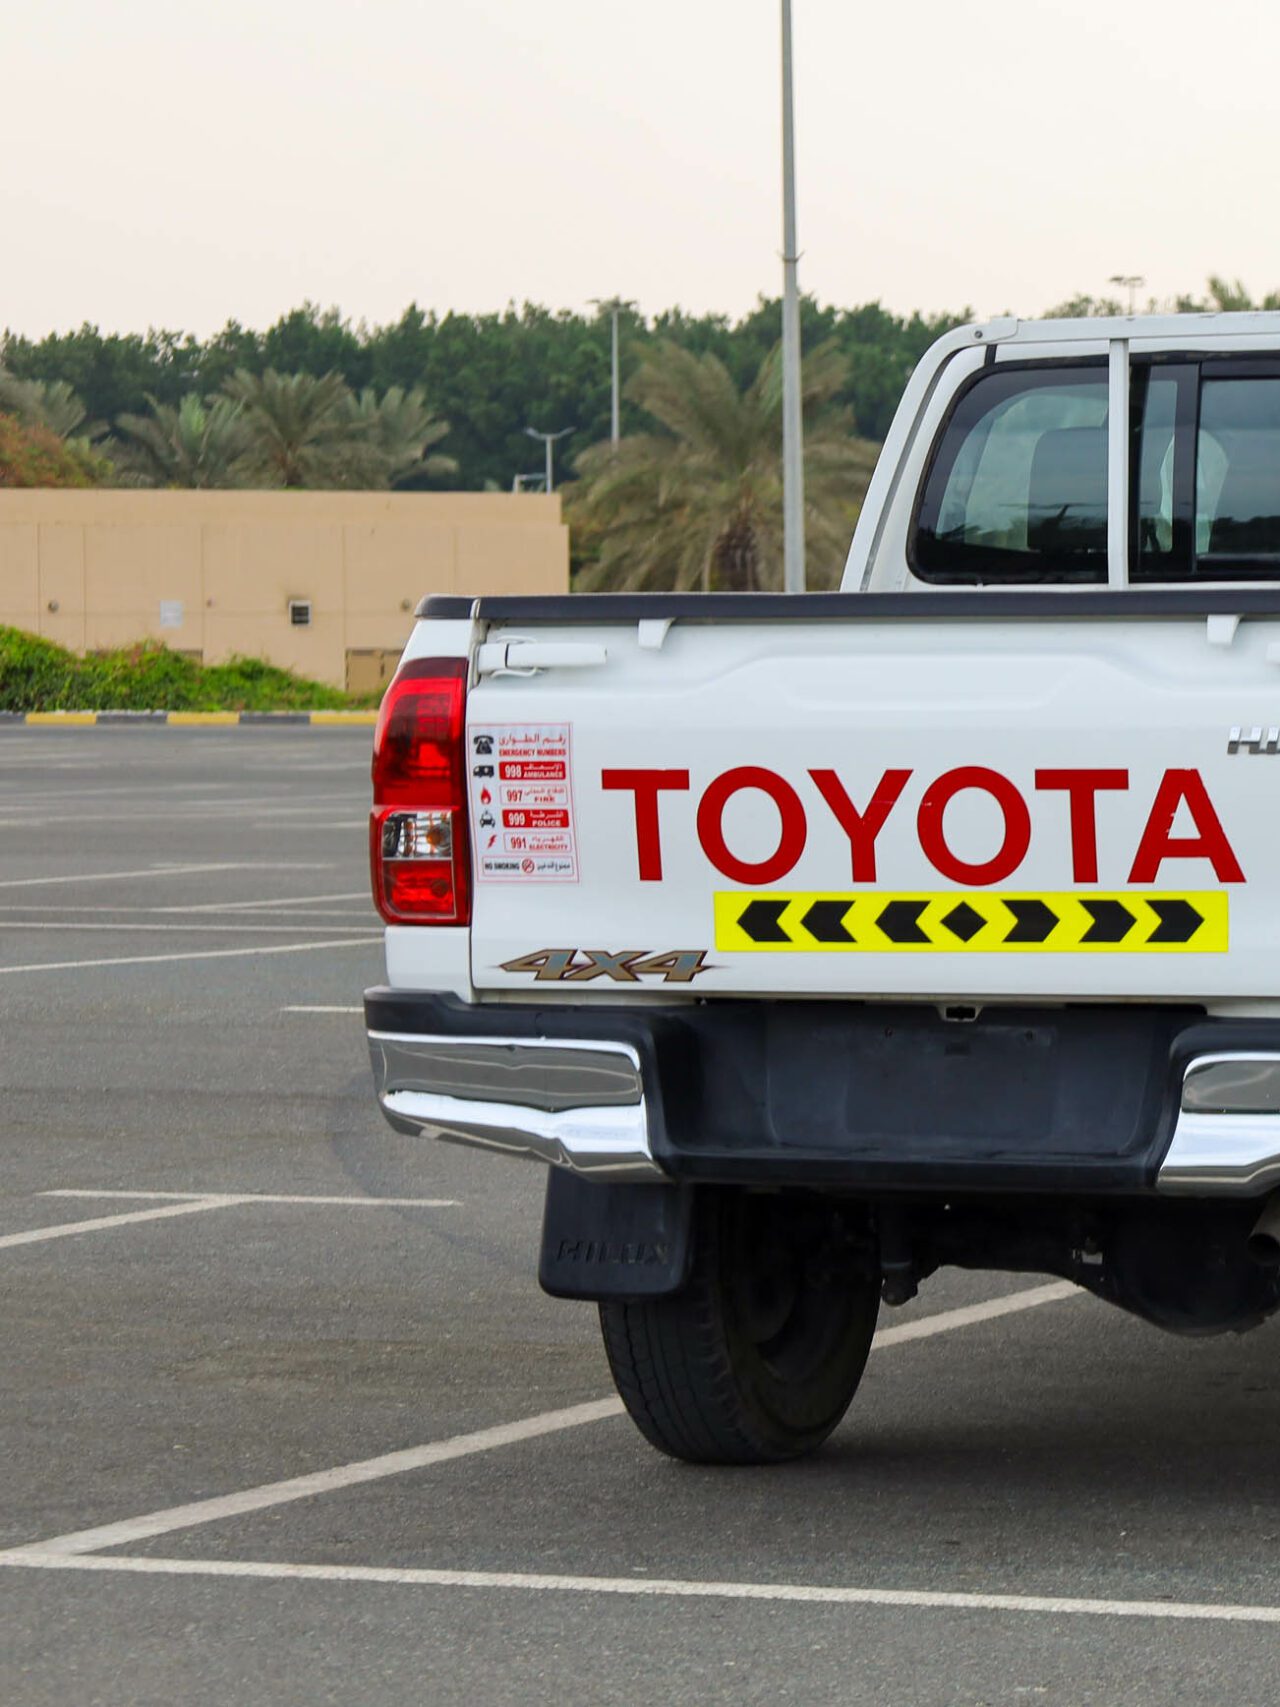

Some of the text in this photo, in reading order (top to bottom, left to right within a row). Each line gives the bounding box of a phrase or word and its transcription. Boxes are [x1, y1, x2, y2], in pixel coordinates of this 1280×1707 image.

[498, 748, 567, 757] EMERGENCY NUMBERS
[505, 764, 522, 778] 998
[506, 789, 523, 802] 997
[508, 812, 526, 826] 999
[532, 819, 561, 827] POLICE
[601, 766, 1247, 886] TOYOTA
[510, 836, 527, 849] 991
[494, 862, 520, 870] SMOKING
